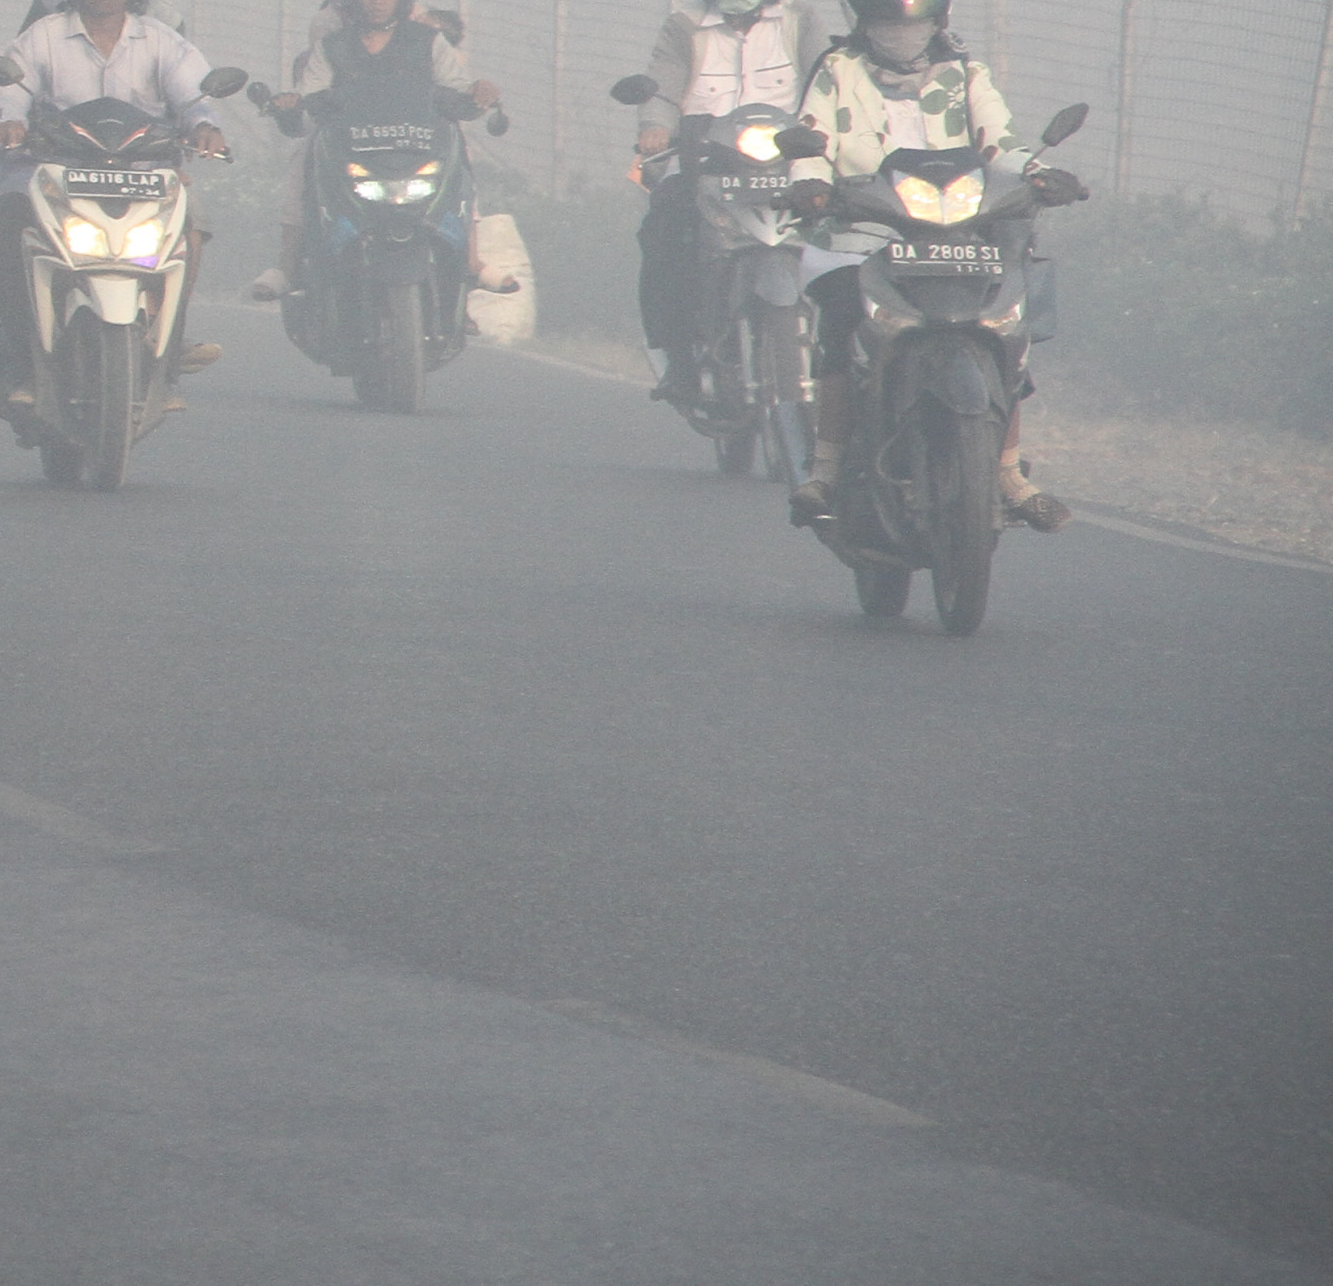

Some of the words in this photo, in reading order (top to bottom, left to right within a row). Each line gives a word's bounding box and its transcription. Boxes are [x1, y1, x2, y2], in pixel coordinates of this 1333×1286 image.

[349, 126, 370, 140] DA
[68, 171, 88, 183] DA
[89, 172, 124, 184] 6116
[128, 174, 160, 186] LAP
[722, 176, 741, 188] DA
[749, 176, 788, 189] 2292
[891, 243, 917, 259] DA
[928, 244, 977, 260] 2806
[980, 245, 1001, 260] SI
